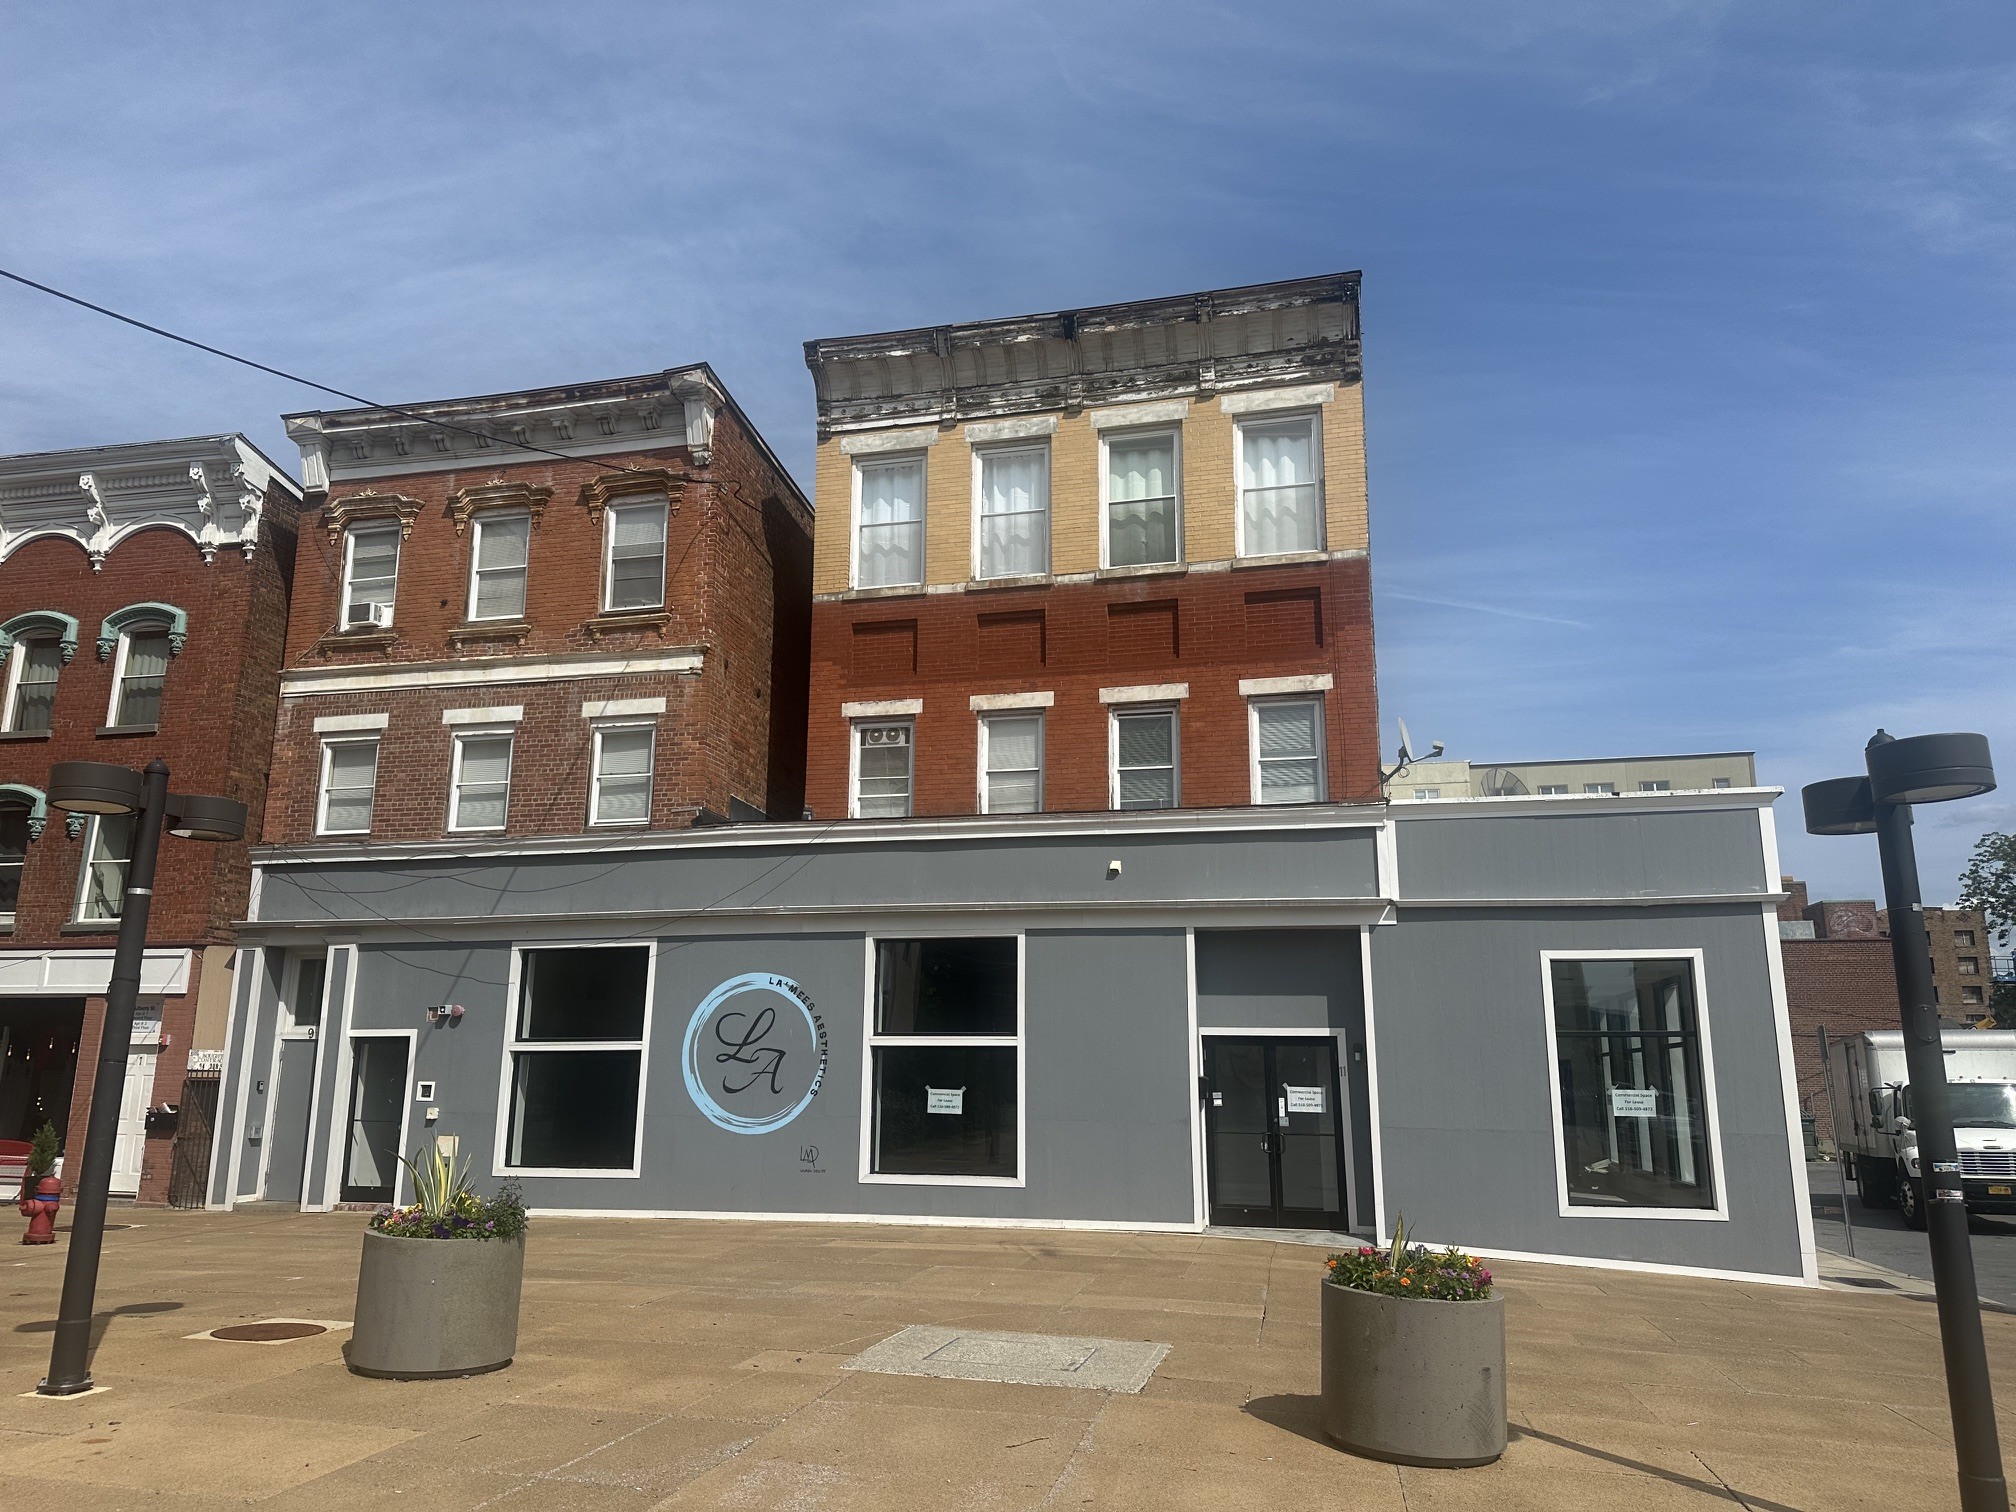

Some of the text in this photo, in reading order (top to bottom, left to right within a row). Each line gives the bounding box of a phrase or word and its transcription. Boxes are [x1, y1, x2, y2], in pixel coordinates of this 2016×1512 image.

[308, 1028, 314, 1039] 9
[810, 1014, 829, 1097] AESTHETICS
[1340, 1066, 1346, 1077] 11
